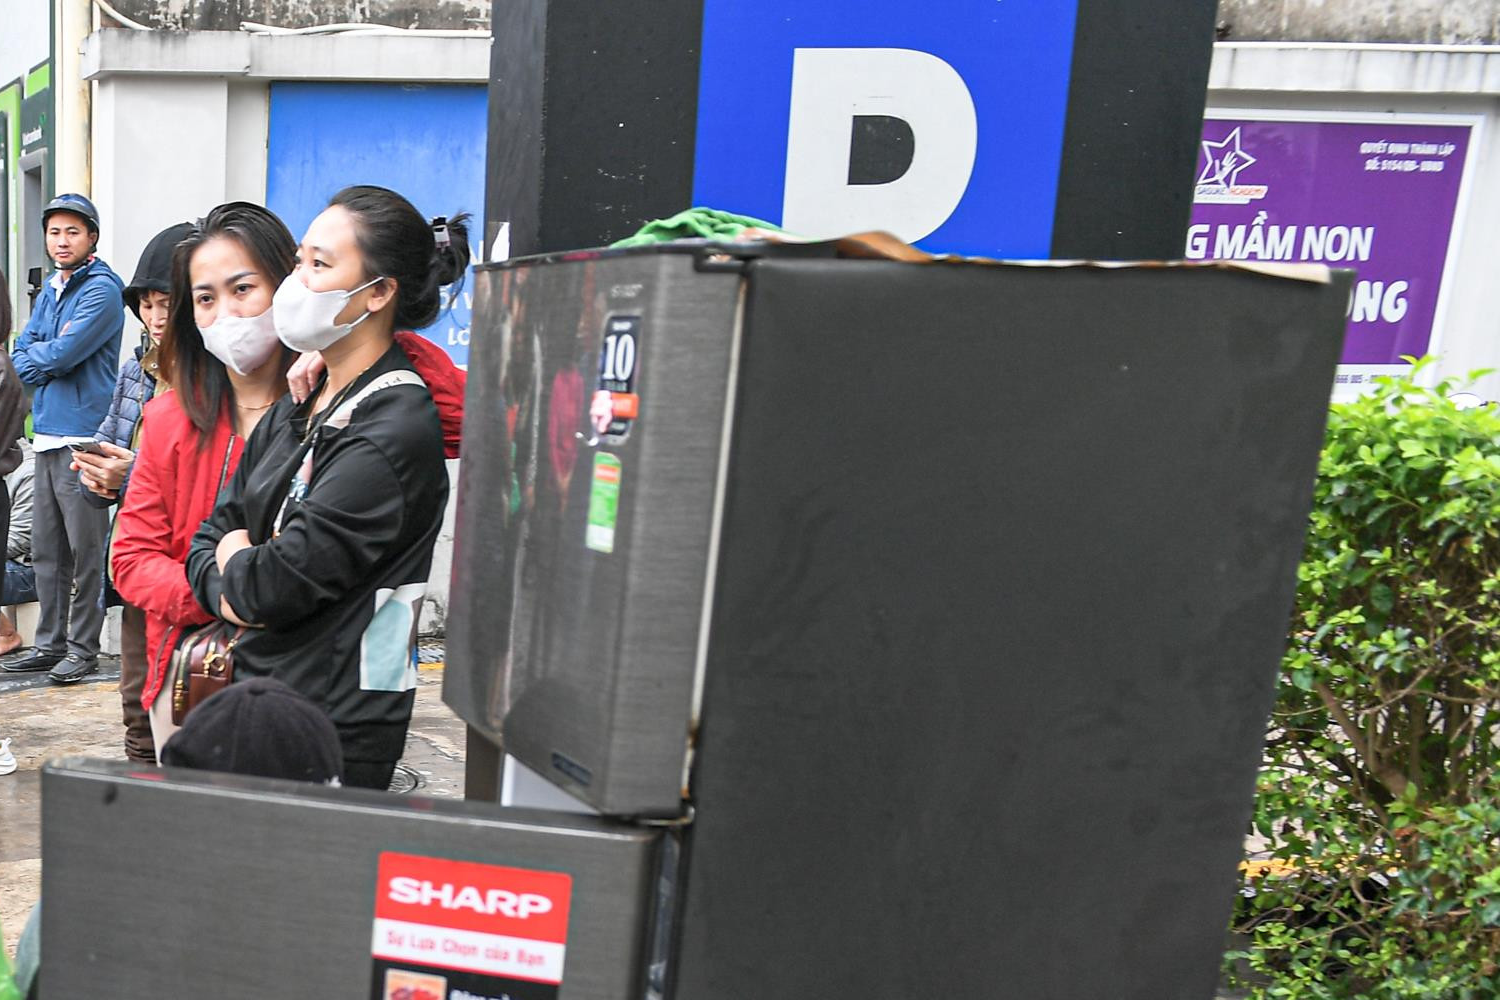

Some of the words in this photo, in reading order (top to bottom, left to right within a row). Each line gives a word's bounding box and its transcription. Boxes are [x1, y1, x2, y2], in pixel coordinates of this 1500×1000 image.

[1213, 210, 1297, 261] MẦM
[1300, 226, 1375, 262] NON
[602, 333, 636, 381] 10
[388, 876, 553, 919] SHARP
